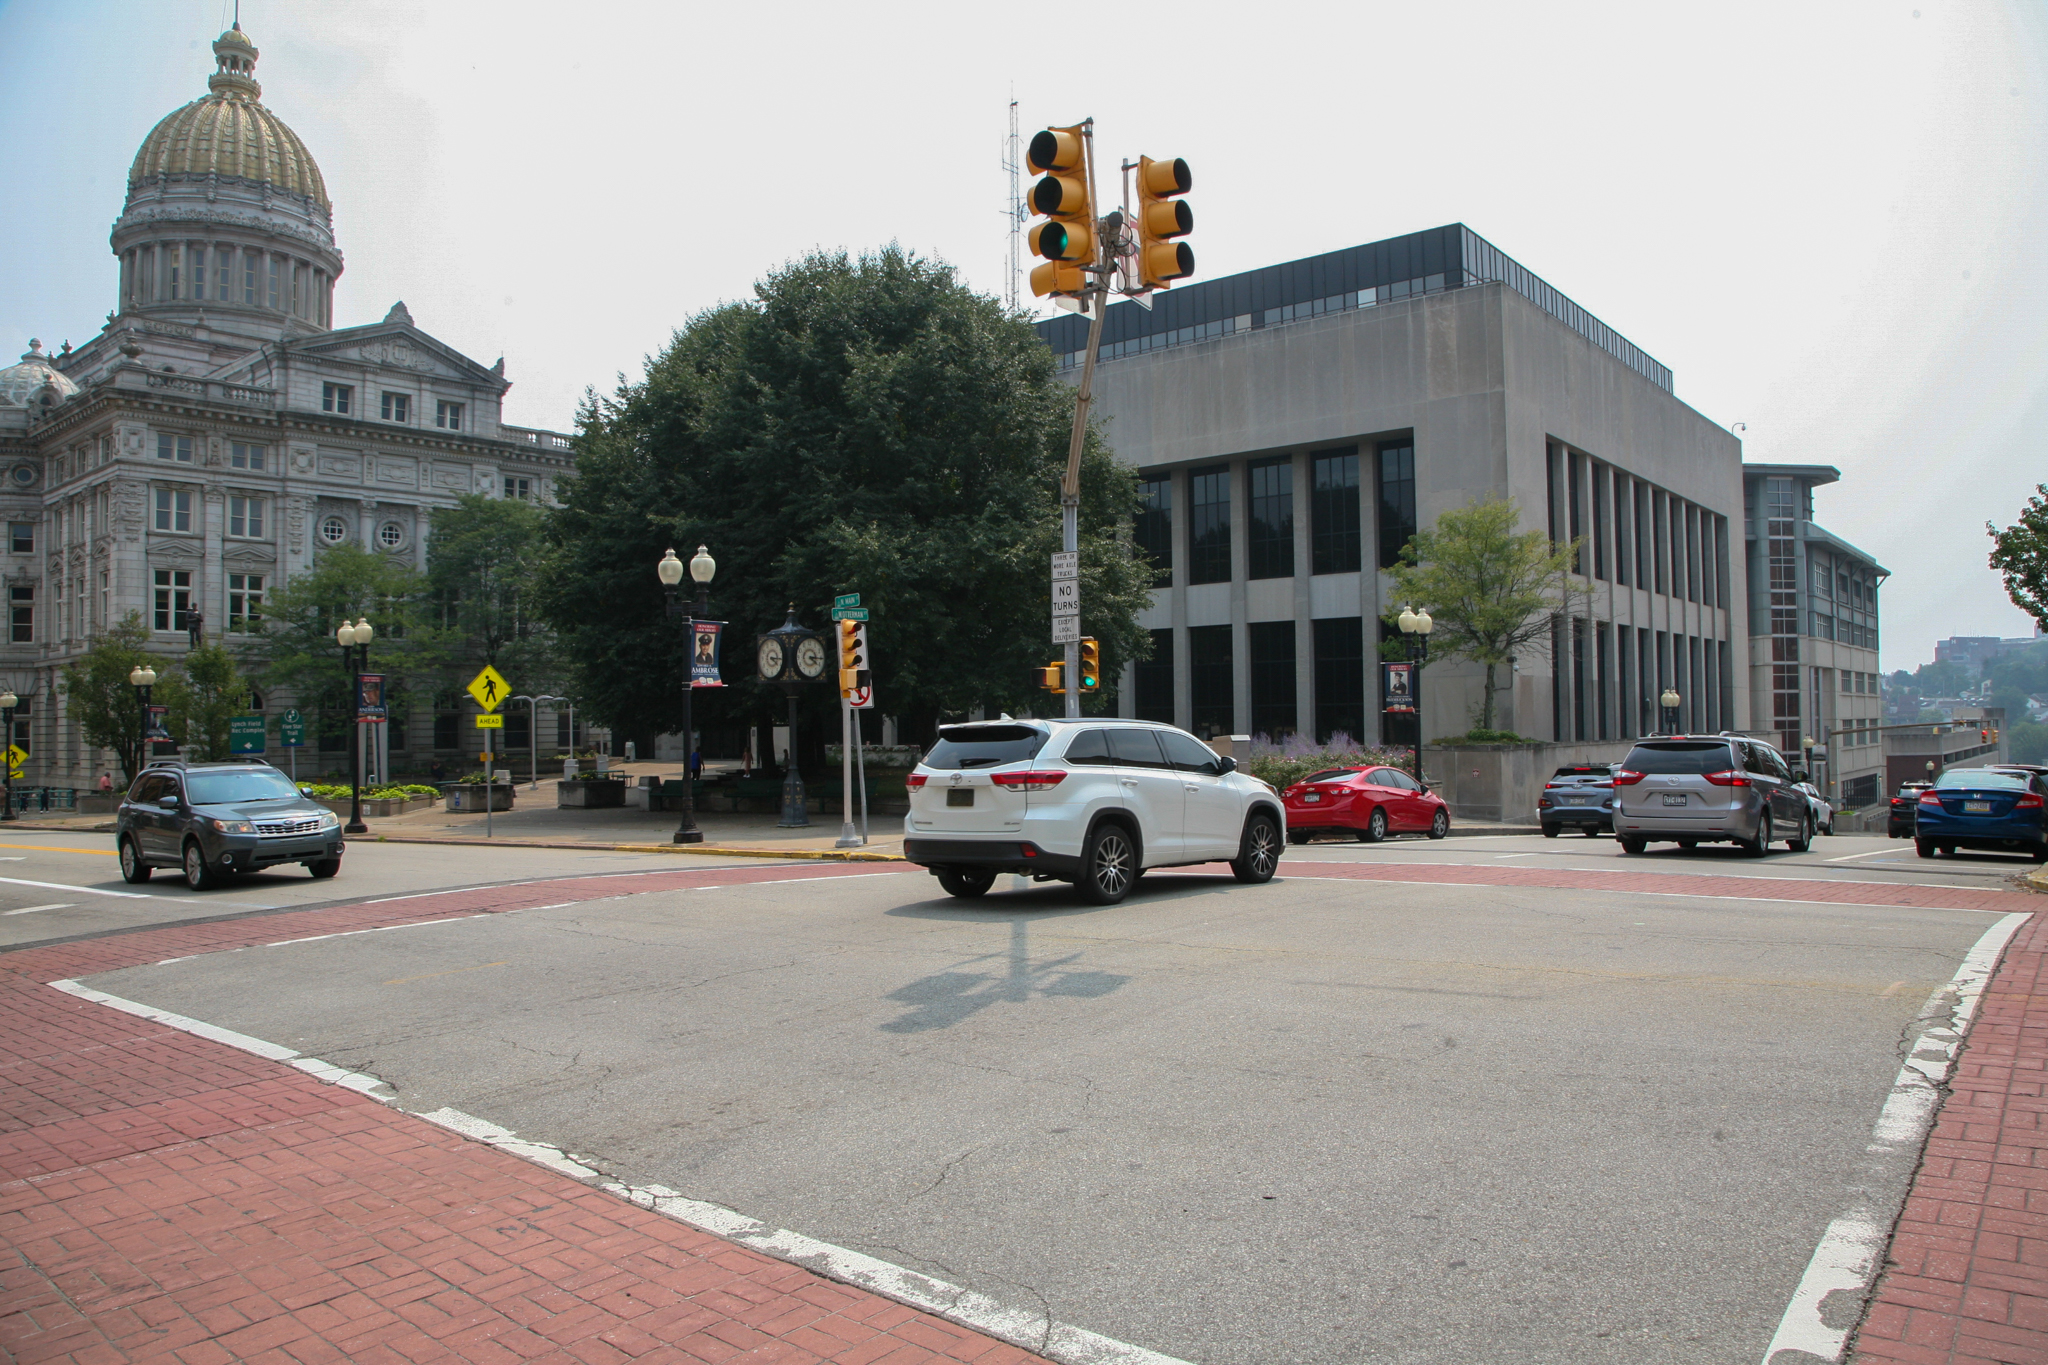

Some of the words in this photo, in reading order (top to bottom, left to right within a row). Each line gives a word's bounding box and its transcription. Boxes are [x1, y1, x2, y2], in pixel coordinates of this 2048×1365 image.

[1059, 586, 1072, 596] NO
[845, 597, 855, 605] MAIN
[1053, 600, 1078, 611] TURNS
[1058, 618, 1073, 626] EXCEPT
[1054, 633, 1078, 641] DELIVERIES
